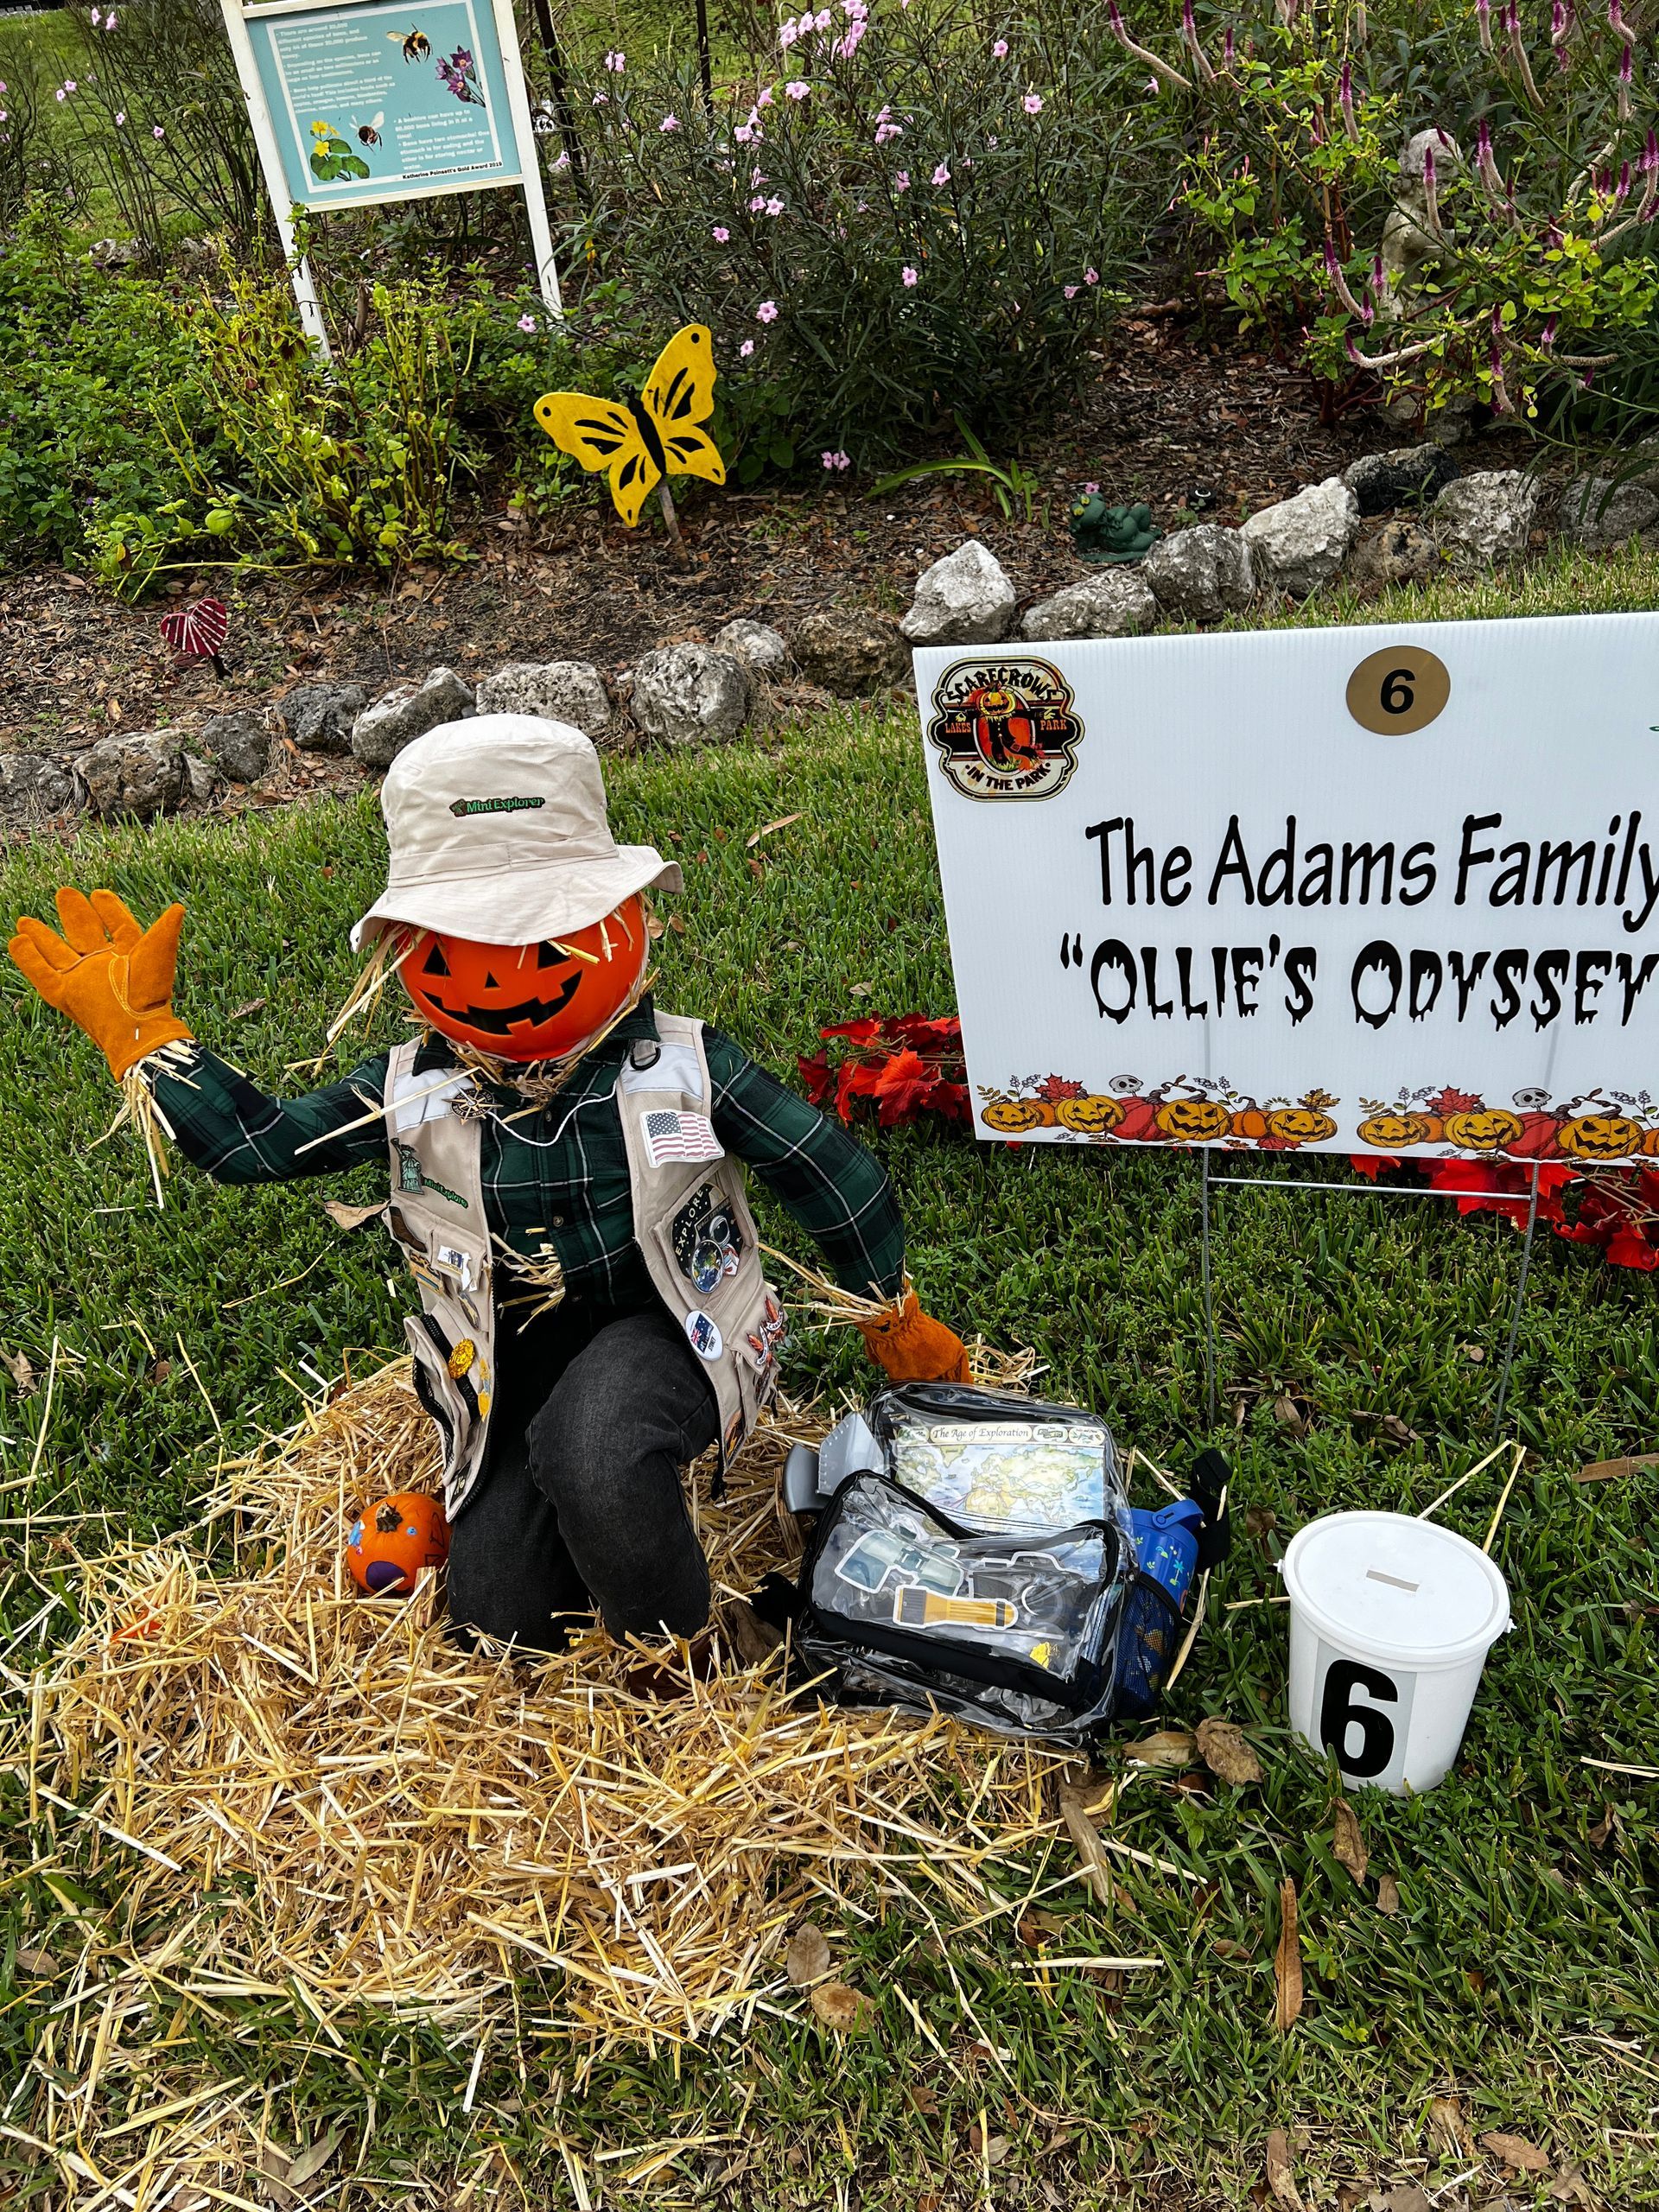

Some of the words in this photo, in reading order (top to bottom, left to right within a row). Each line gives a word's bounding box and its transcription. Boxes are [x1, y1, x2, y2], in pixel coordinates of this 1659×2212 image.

[947, 667, 1056, 705] SCARECROWS
[1379, 668, 1414, 715] 6
[945, 722, 971, 733] LAKES
[1040, 720, 1066, 730] PARK
[967, 767, 982, 782] IN
[987, 778, 1014, 790] THE
[1017, 767, 1052, 789] PARK
[467, 800, 492, 812] Mini
[494, 797, 543, 810] Explorer
[1085, 817, 1192, 907] The
[1208, 815, 1436, 907] Adams
[1351, 939, 1659, 1033] ODYSSEY
[675, 1189, 703, 1256] EXPLORE
[933, 1428, 949, 1438] The
[950, 1429, 966, 1441] Age
[969, 1426, 978, 1441] of
[979, 1426, 1028, 1440] Exploration
[1320, 1659, 1398, 1778] 6
